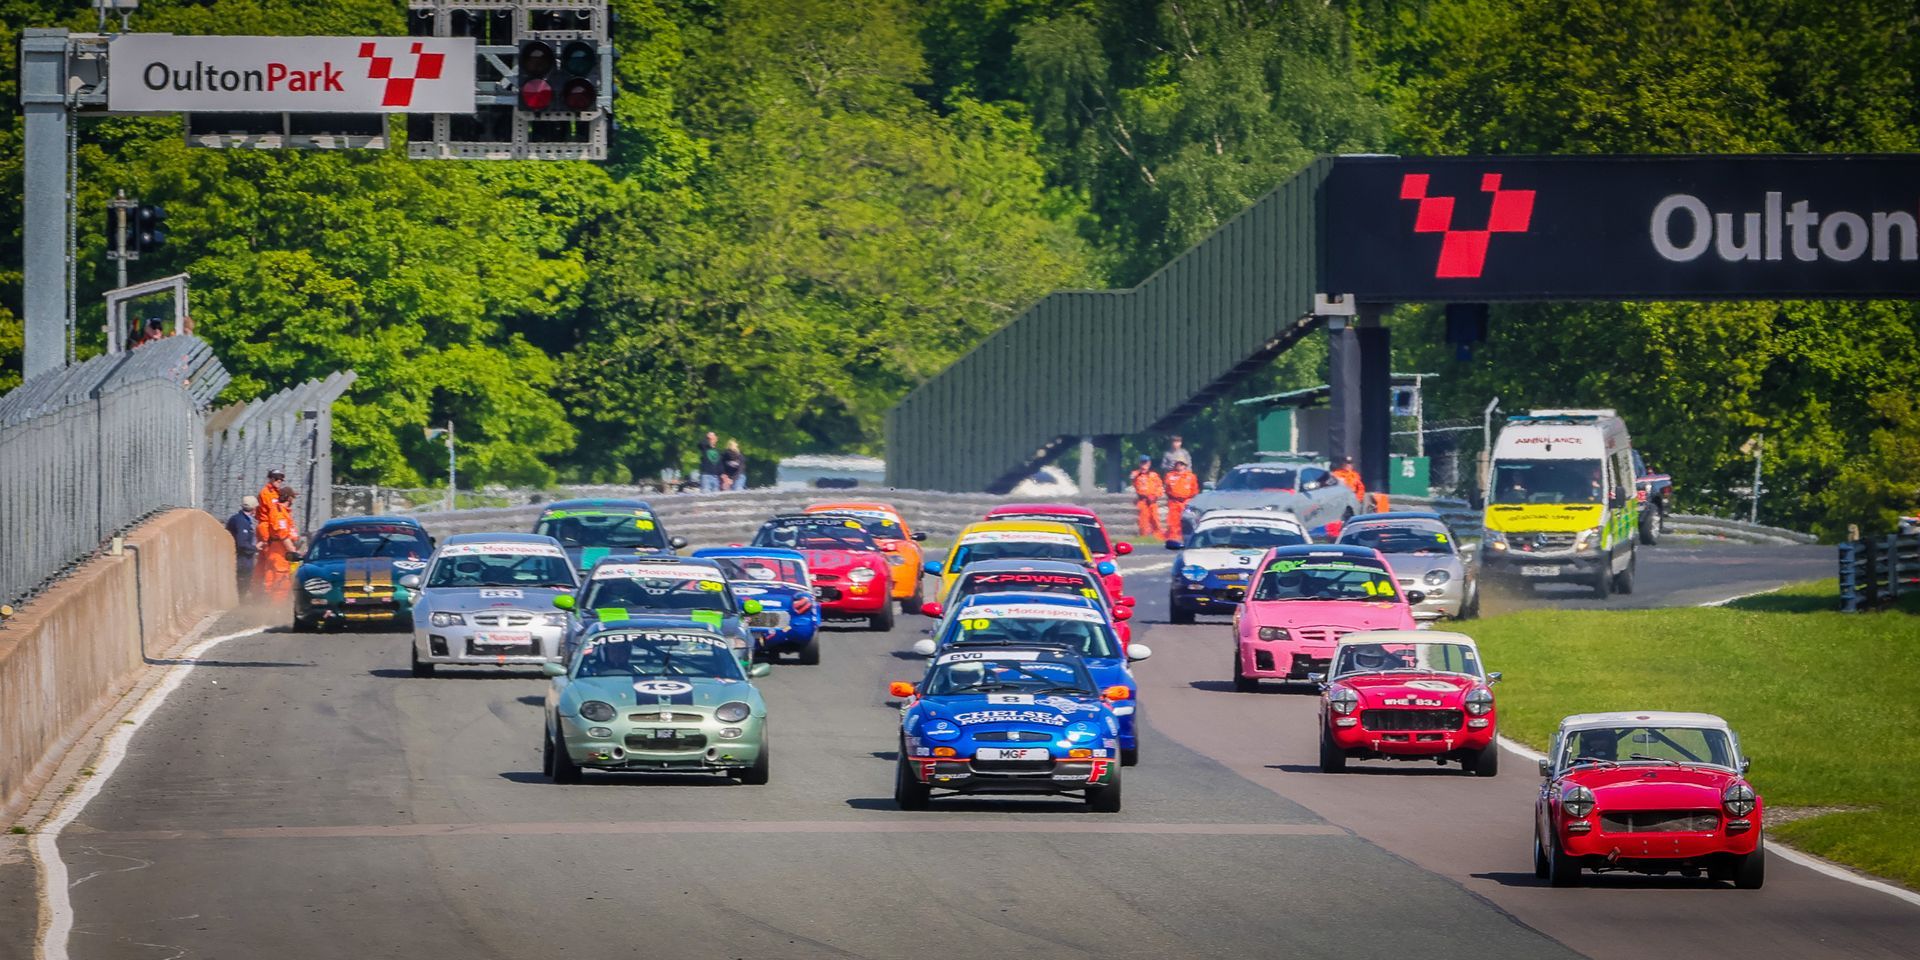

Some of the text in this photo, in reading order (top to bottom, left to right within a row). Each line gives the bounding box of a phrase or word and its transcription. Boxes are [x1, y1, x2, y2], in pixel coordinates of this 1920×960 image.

[143, 61, 345, 92] OultonPark
[1650, 191, 1919, 262] Oulton
[1436, 533, 1449, 543] 2
[1239, 556, 1251, 565] 9
[1361, 581, 1395, 596] 14
[1007, 607, 1079, 617] Motorsport
[960, 618, 990, 630] 10
[588, 634, 641, 649] MGF
[954, 710, 1070, 723] CHELSEA
[961, 715, 1065, 726] FOOTBALL CLUB
[999, 749, 1027, 759] MGF
[1087, 760, 1108, 784] F
